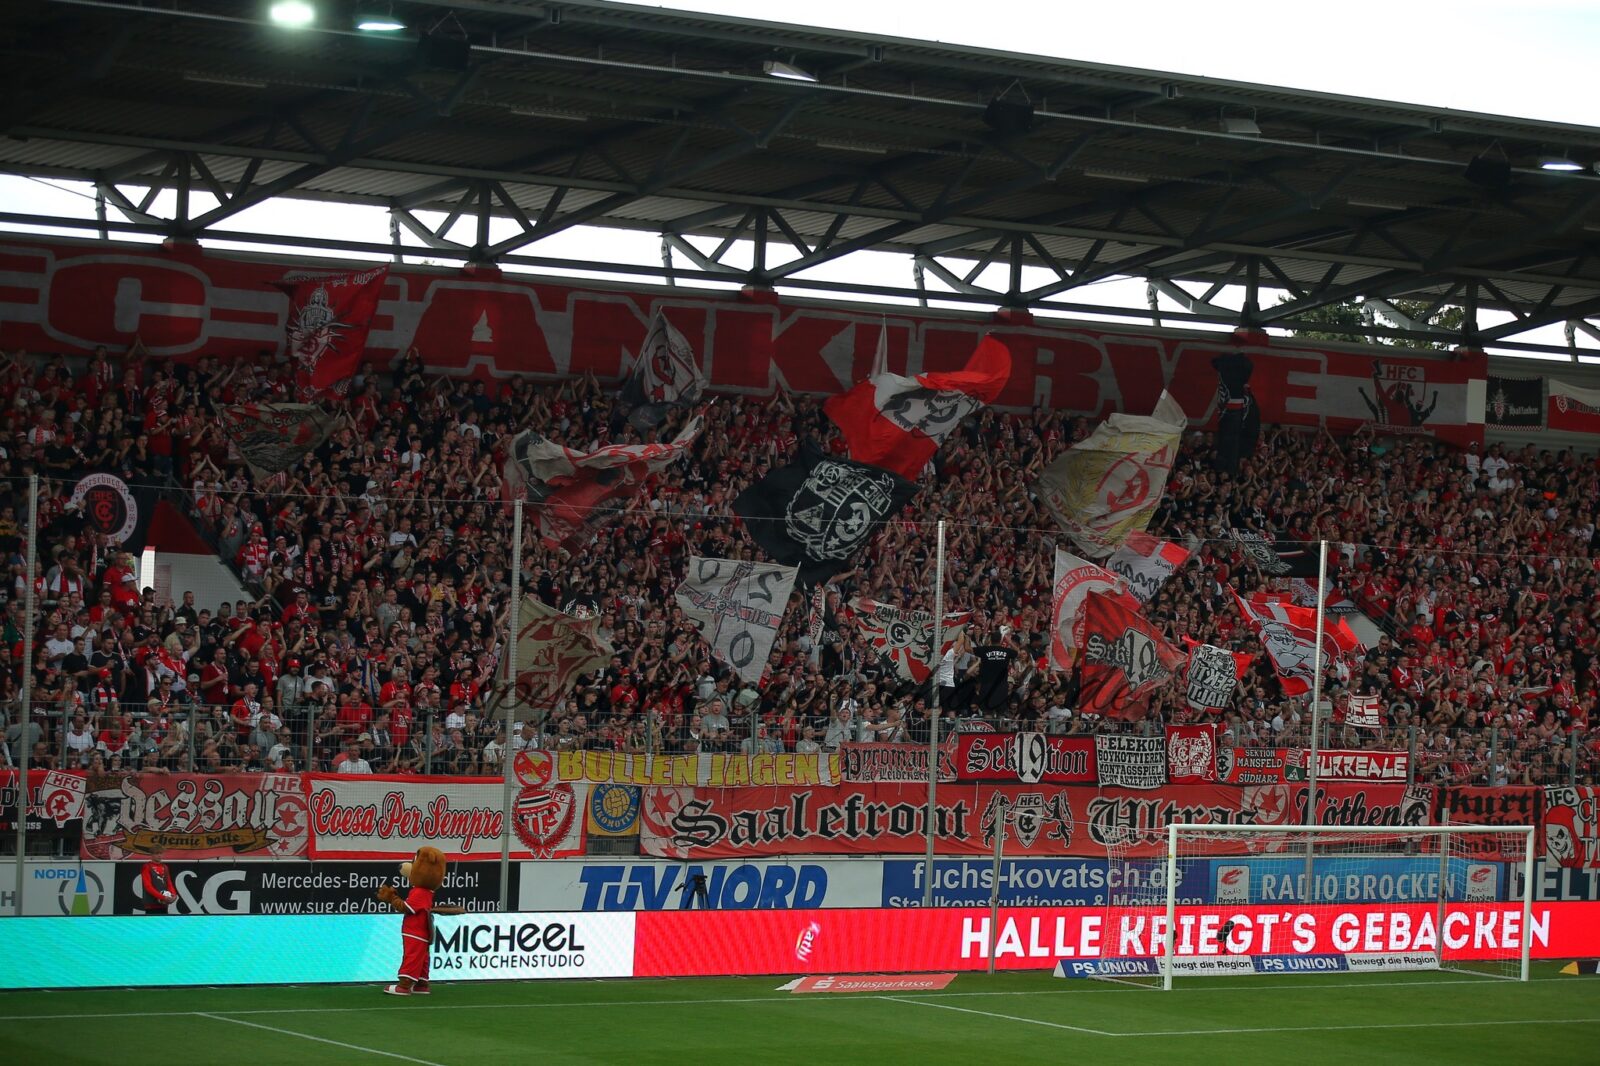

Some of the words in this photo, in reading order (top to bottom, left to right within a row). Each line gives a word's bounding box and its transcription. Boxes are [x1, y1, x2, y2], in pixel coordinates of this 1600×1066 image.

[1386, 364, 1418, 380] HFC
[1096, 736, 1165, 752] TELEKOM
[1098, 749, 1165, 764] BOYKOTTIEREN
[1236, 757, 1283, 768] MANSFELD
[557, 749, 699, 786] BULLEN
[707, 752, 822, 786] JAGEN
[53, 774, 80, 790] HFC
[1238, 773, 1278, 784] SÜDHARZ
[1020, 795, 1041, 806] HFC
[11, 821, 42, 830] WISS
[423, 794, 504, 853] Sempre
[671, 790, 970, 848] Saalefront
[34, 868, 77, 880] NORD
[261, 872, 387, 890] Mercedes-Benz
[441, 871, 479, 889] dich!
[912, 861, 1183, 889] fuchs-kovatsch.de
[680, 864, 828, 911] NORD
[1345, 872, 1456, 900] BROCKEN
[960, 915, 1102, 958] HALLE
[1331, 910, 1551, 951] GEBACKEN
[433, 955, 463, 970] DAS
[469, 954, 586, 969] KÜCHENSTUDIO
[1073, 961, 1095, 974] PS
[1099, 960, 1150, 974] UNION
[1159, 960, 1198, 972] bwegt
[1200, 960, 1215, 969] die
[1217, 959, 1252, 971] Region
[1262, 958, 1283, 971] PS
[1287, 956, 1339, 970] UNION
[1350, 956, 1386, 967] bewegt
[1387, 955, 1402, 965] die
[1403, 954, 1436, 965] Region
[837, 978, 934, 991] Saalesparkasse
